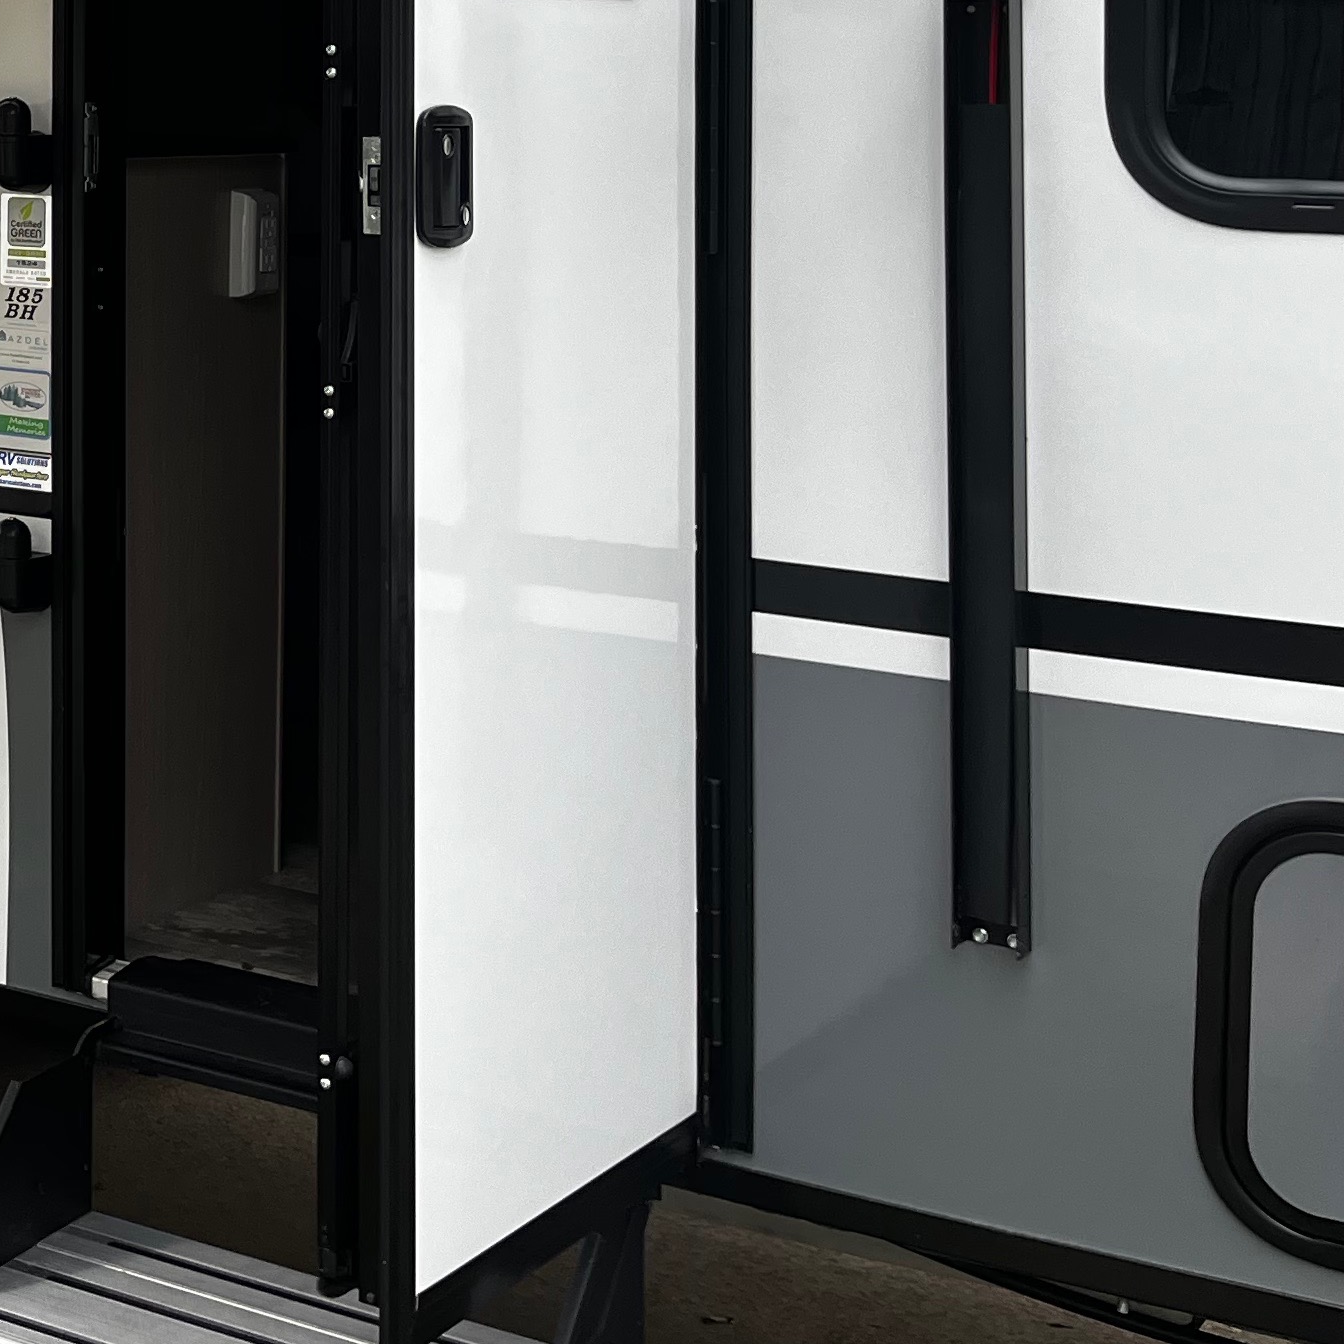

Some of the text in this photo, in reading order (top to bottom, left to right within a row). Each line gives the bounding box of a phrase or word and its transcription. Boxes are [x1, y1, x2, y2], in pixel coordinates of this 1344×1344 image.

[10, 219, 43, 229] Certified
[10, 228, 42, 239] GREEN
[4, 287, 44, 304] 185
[4, 304, 38, 321] BH
[7, 335, 49, 346] AZDEL
[9, 417, 44, 430] Making
[6, 425, 46, 436] Memories
[16, 456, 49, 467] SOLUTIONS
